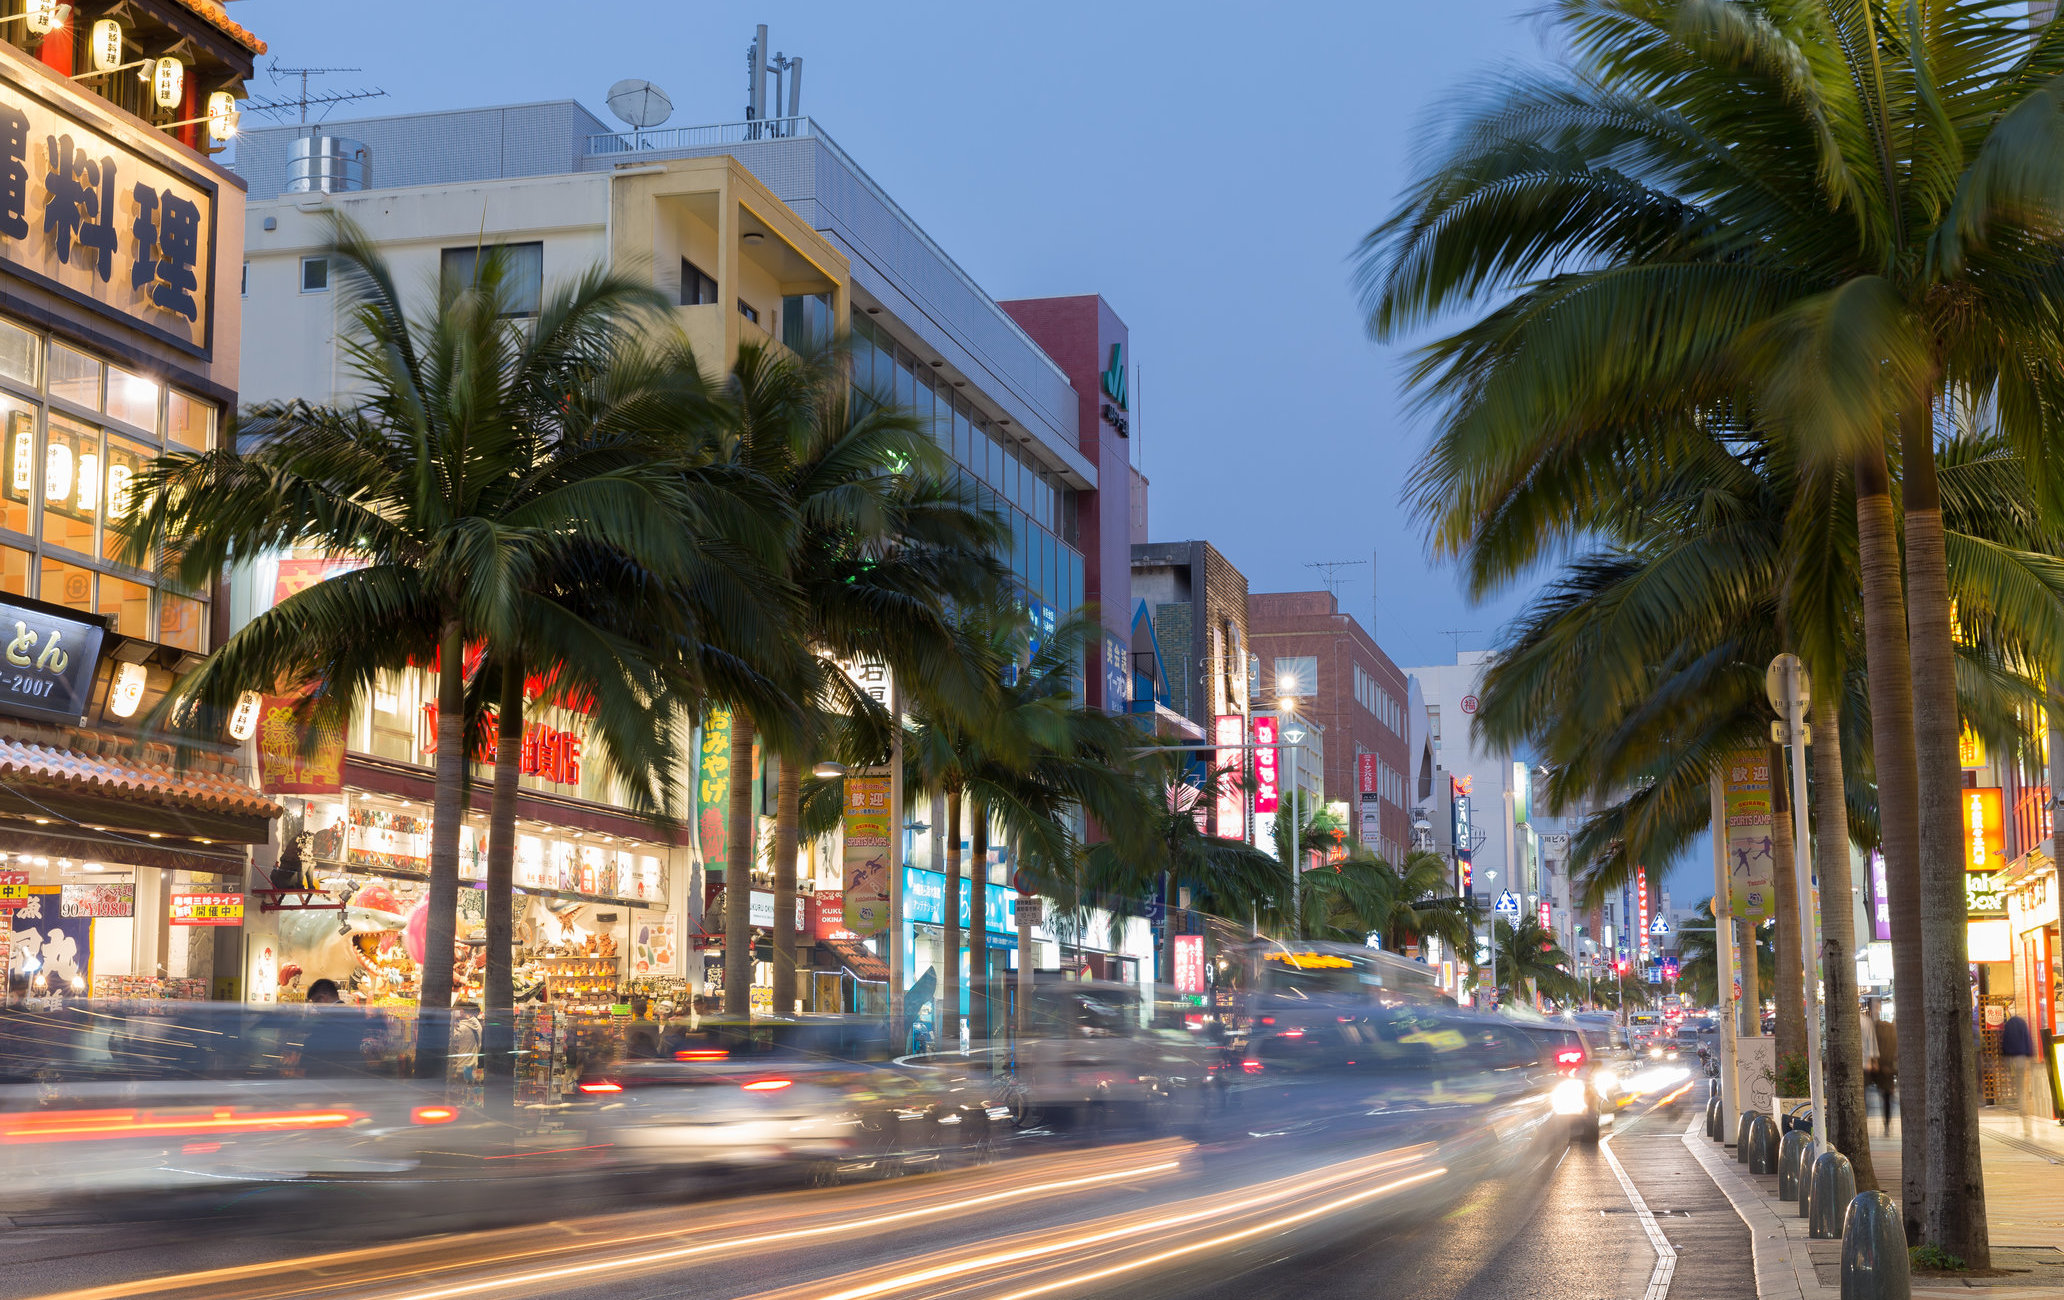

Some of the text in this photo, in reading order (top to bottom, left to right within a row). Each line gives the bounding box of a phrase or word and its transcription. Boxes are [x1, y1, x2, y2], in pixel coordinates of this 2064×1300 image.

[6, 621, 69, 675] とん
[0, 673, 54, 698] -2007
[702, 707, 730, 803] おみやげ
[1731, 766, 1769, 783] 歓迎
[851, 792, 884, 807] 歓迎
[1730, 815, 1753, 827] SPORTS
[847, 837, 887, 847] SPORTS CAMPS
